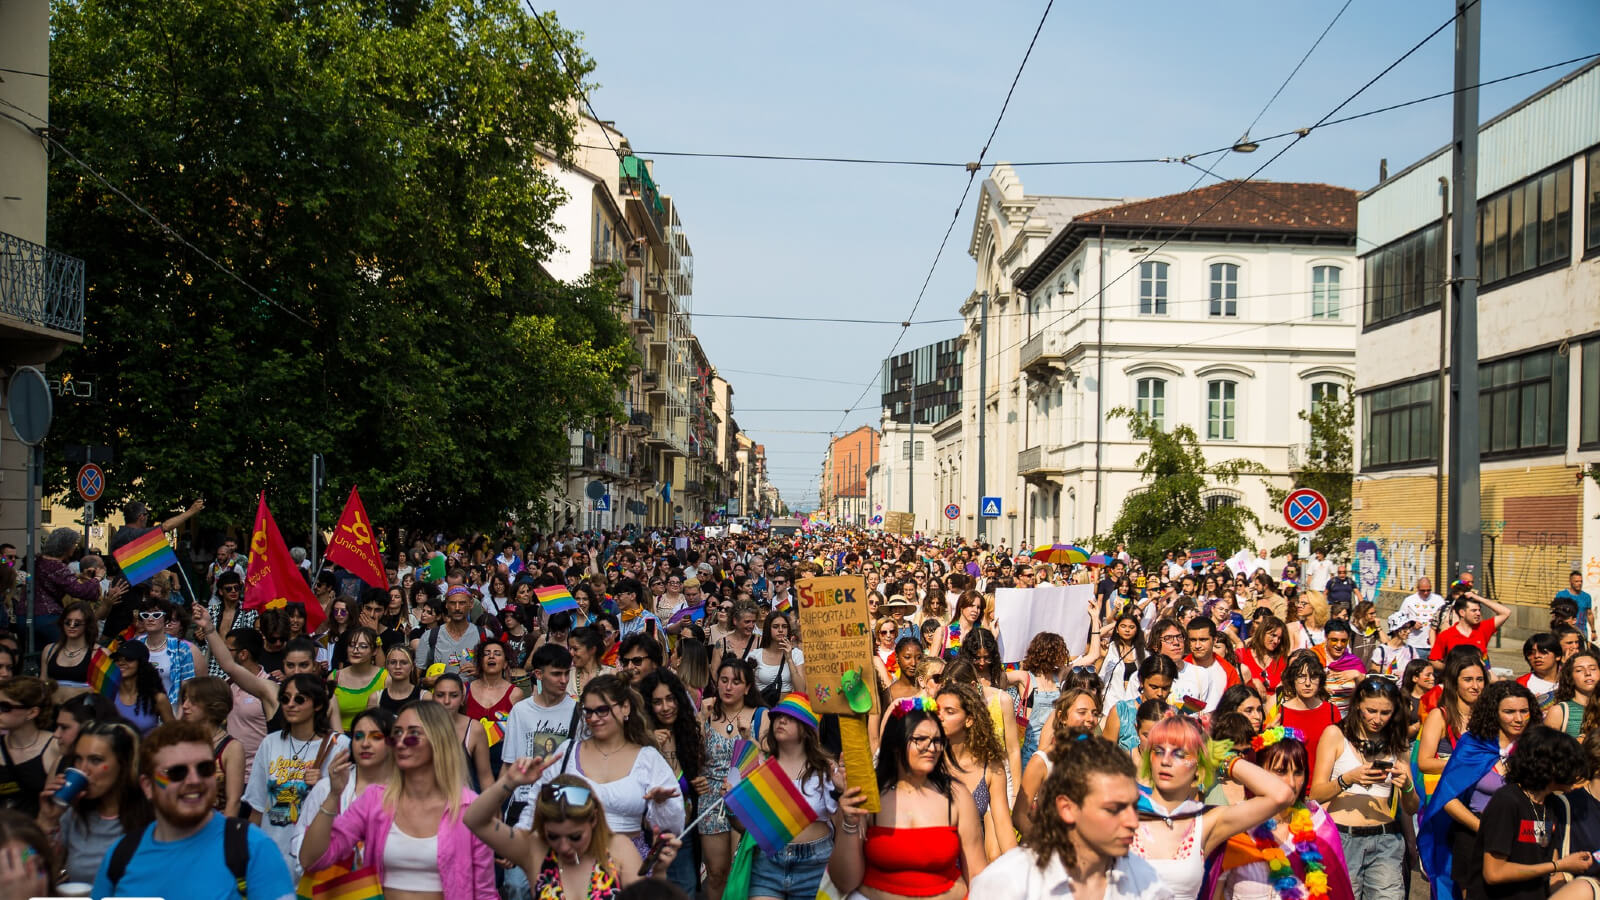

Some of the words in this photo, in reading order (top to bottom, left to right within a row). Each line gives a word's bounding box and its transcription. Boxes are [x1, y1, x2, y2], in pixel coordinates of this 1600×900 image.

[334, 535, 367, 560] Unione
[801, 610, 844, 624] SUPPORTA
[845, 608, 856, 619] LA
[840, 622, 869, 637] LGBT+
[816, 641, 834, 651] COME
[269, 755, 305, 774] Venice
